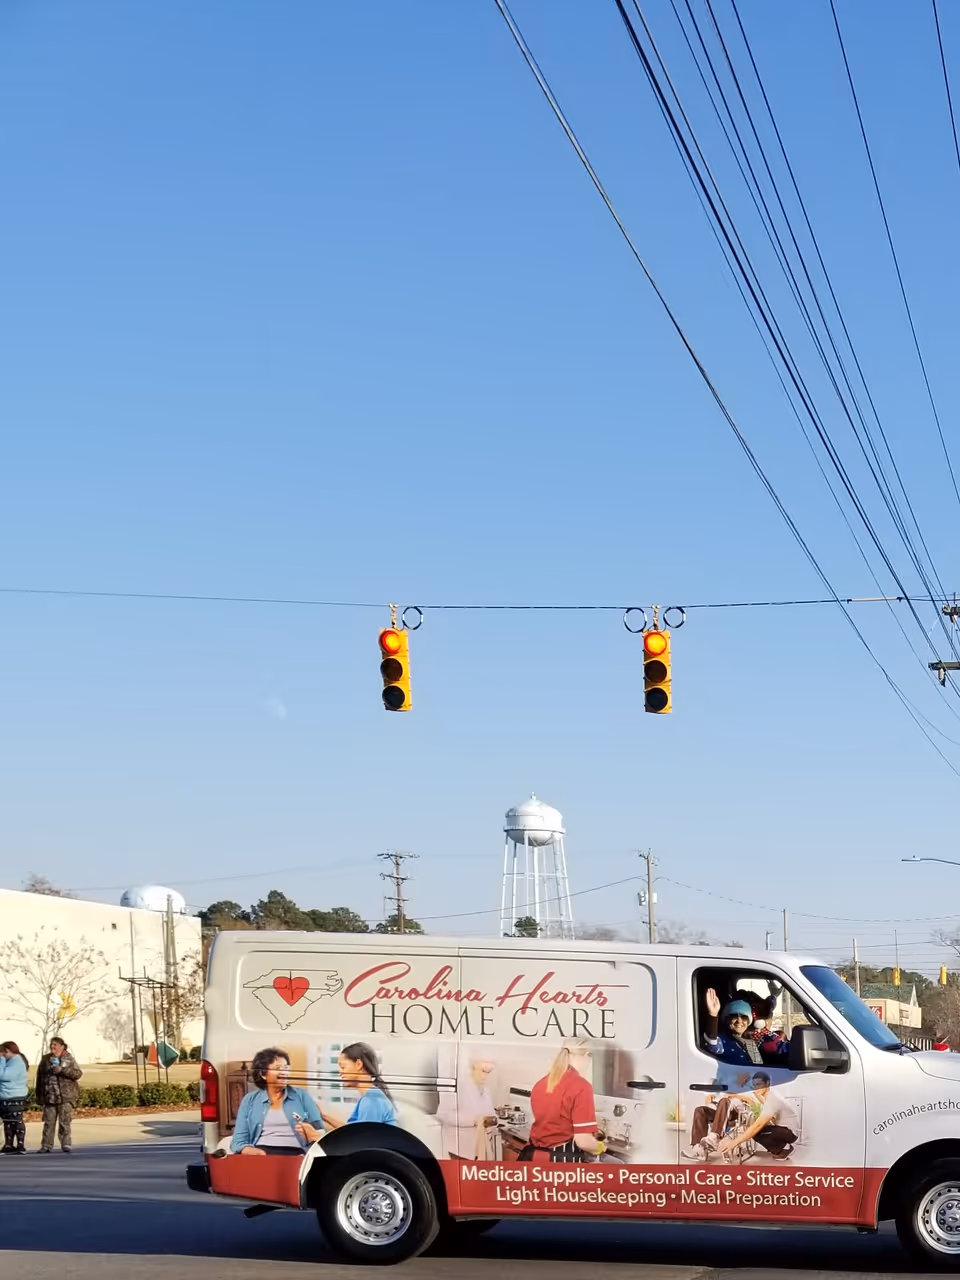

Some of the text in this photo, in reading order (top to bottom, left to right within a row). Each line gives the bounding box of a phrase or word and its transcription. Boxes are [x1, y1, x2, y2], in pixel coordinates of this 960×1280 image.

[344, 961, 630, 1015] Carolina Hearts
[370, 1003, 616, 1039] HOME CARE
[461, 1165, 855, 1188] Medical Supplies Personal Care Sitter Service
[496, 1186, 821, 1208] Light Housekeeping Meal Preparation
